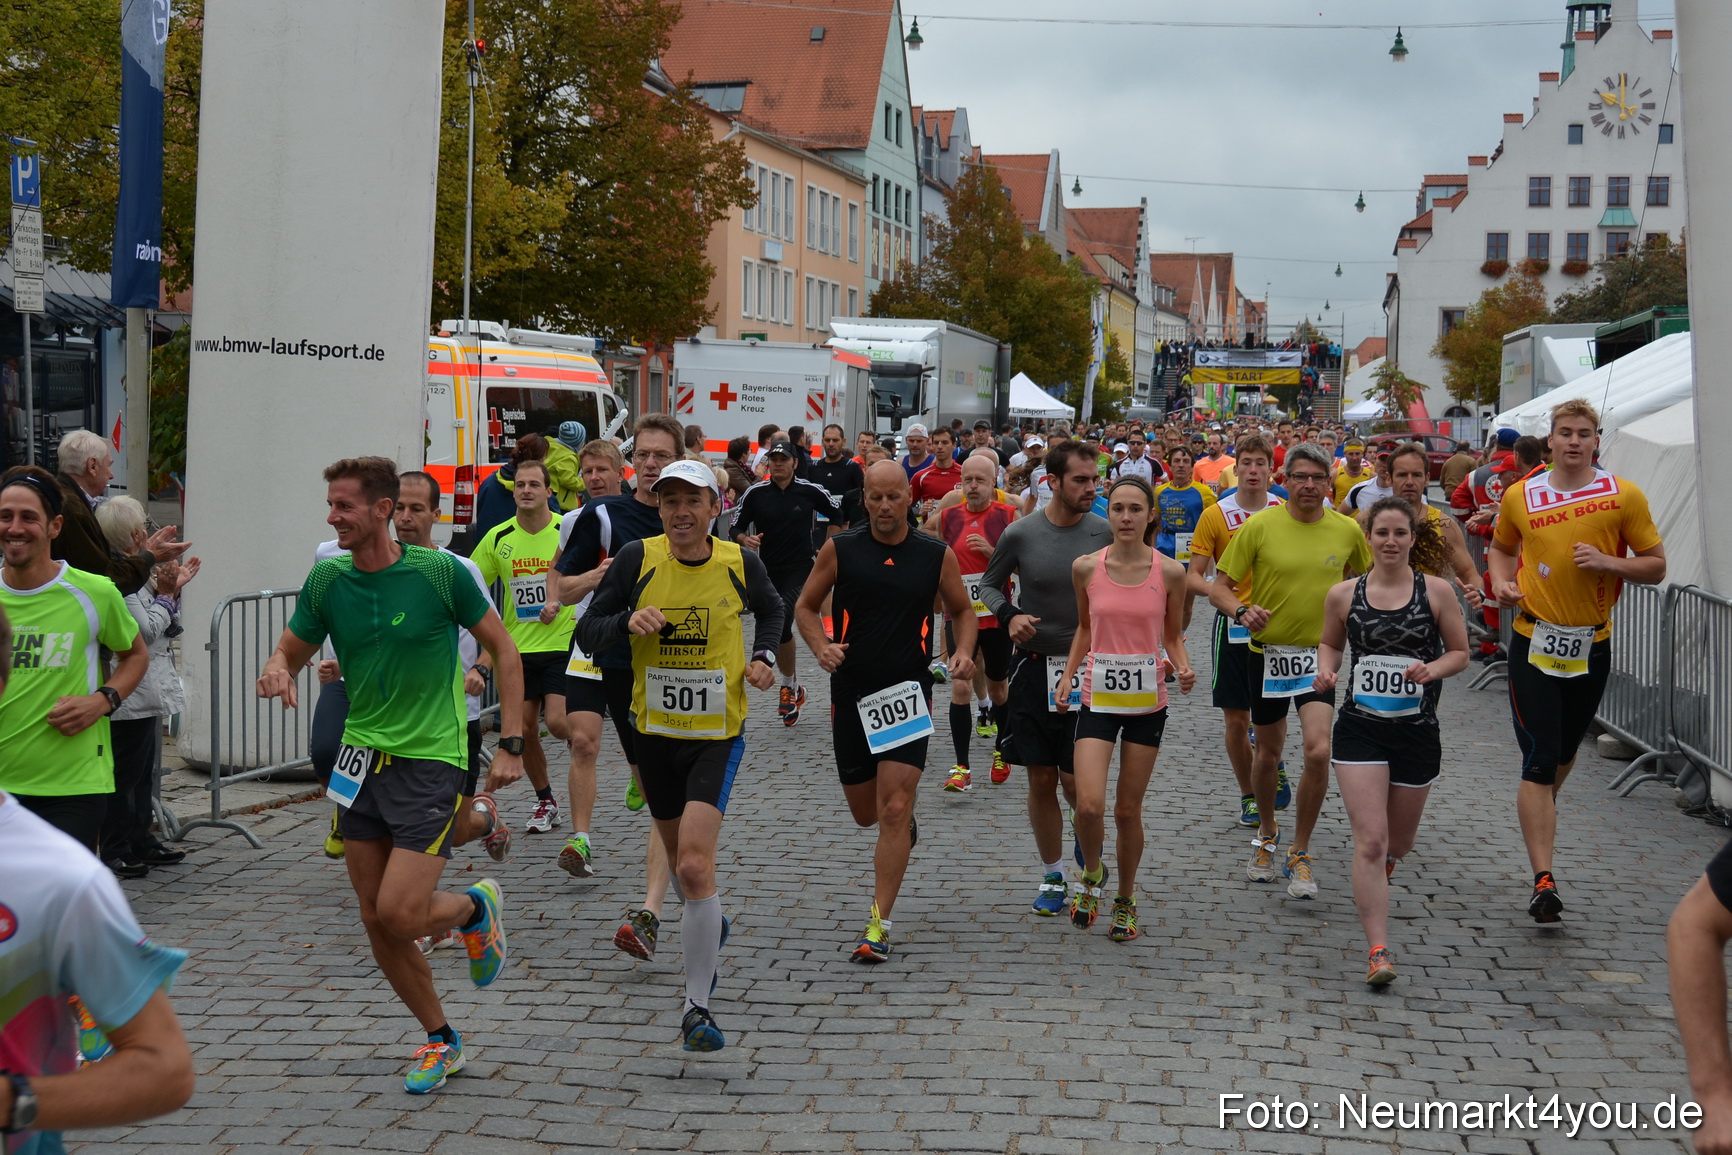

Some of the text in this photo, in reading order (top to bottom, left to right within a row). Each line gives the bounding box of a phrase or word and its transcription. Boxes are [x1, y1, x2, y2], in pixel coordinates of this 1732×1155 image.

[17, 235, 39, 247] werktags
[195, 336, 384, 361] www.bmw-laufsport.de
[1226, 372, 1264, 381] START
[742, 384, 792, 394] Bayerisches
[742, 394, 765, 403] Rotes
[741, 405, 765, 413] Kreuz
[1012, 407, 1046, 416] Laufsport
[1529, 500, 1621, 530] MAX BÖGL
[512, 557, 551, 568] Müller
[516, 586, 546, 605] 250
[660, 646, 706, 656] HIRSCH
[1543, 634, 1582, 658] 358
[1095, 658, 1114, 666] PARTL
[1269, 655, 1315, 677] 3062
[1551, 660, 1566, 671] Jan
[647, 672, 712, 684] PARTL Neumarkt
[1104, 668, 1143, 691] 531
[1273, 680, 1301, 690] RALF
[1361, 669, 1417, 695] 3096
[662, 685, 708, 712] 501
[859, 687, 910, 710] PARTL Neumarkt
[867, 693, 918, 730] 3097
[662, 713, 696, 729] Josef
[337, 744, 365, 777] 06
